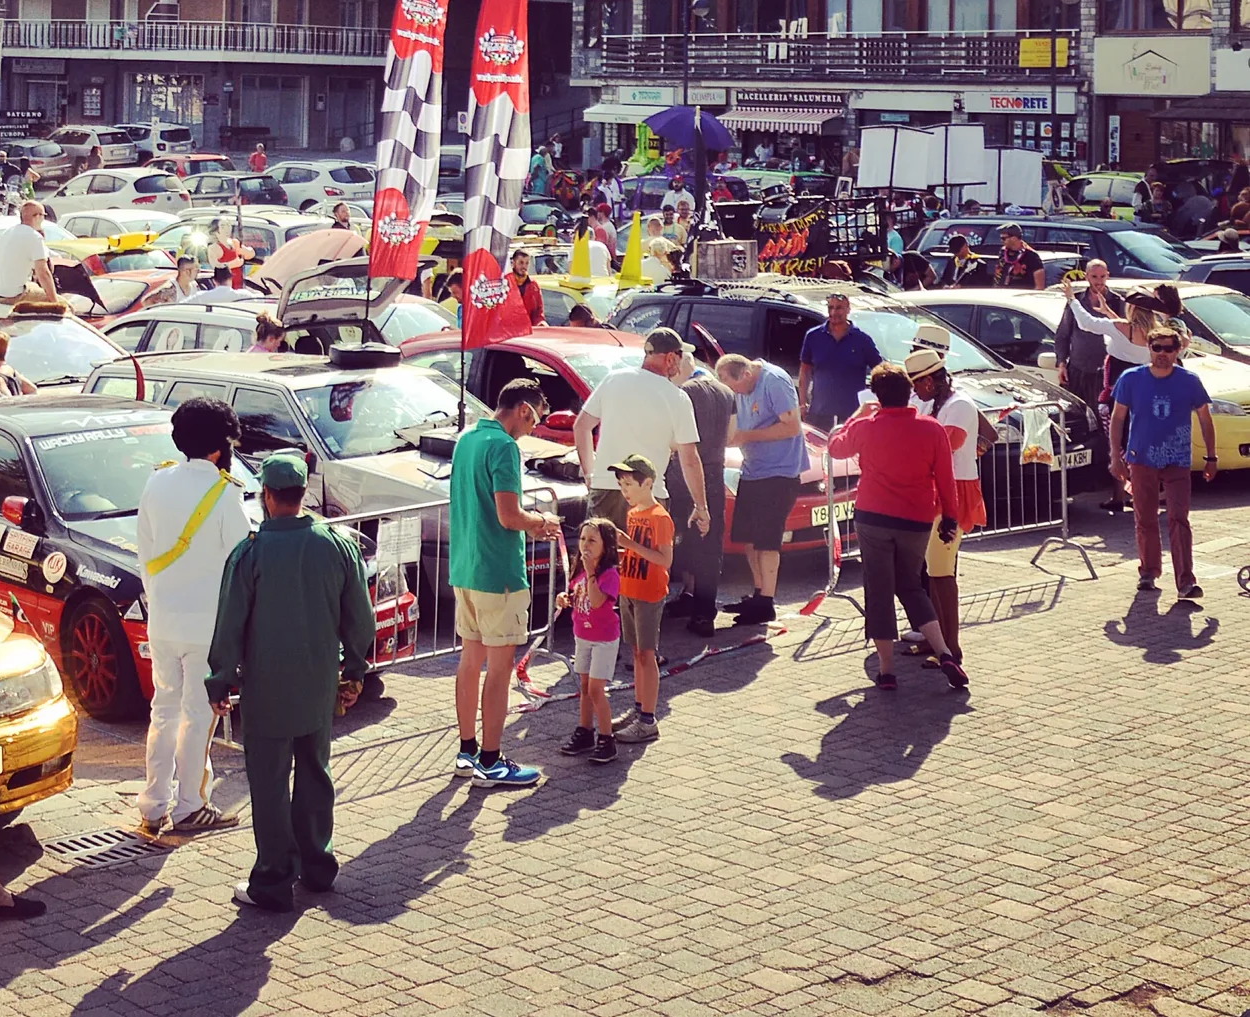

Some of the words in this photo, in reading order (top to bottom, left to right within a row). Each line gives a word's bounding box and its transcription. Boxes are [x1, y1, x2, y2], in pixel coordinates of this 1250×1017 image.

[737, 90, 788, 102] MACELLERIA
[793, 91, 842, 103] SALUMERIA
[990, 96, 1048, 109] TECNORETE
[38, 432, 86, 451] WACKY
[85, 427, 128, 445] RALLY
[6, 542, 32, 556] GARAGE
[75, 564, 121, 589] Kawasaki
